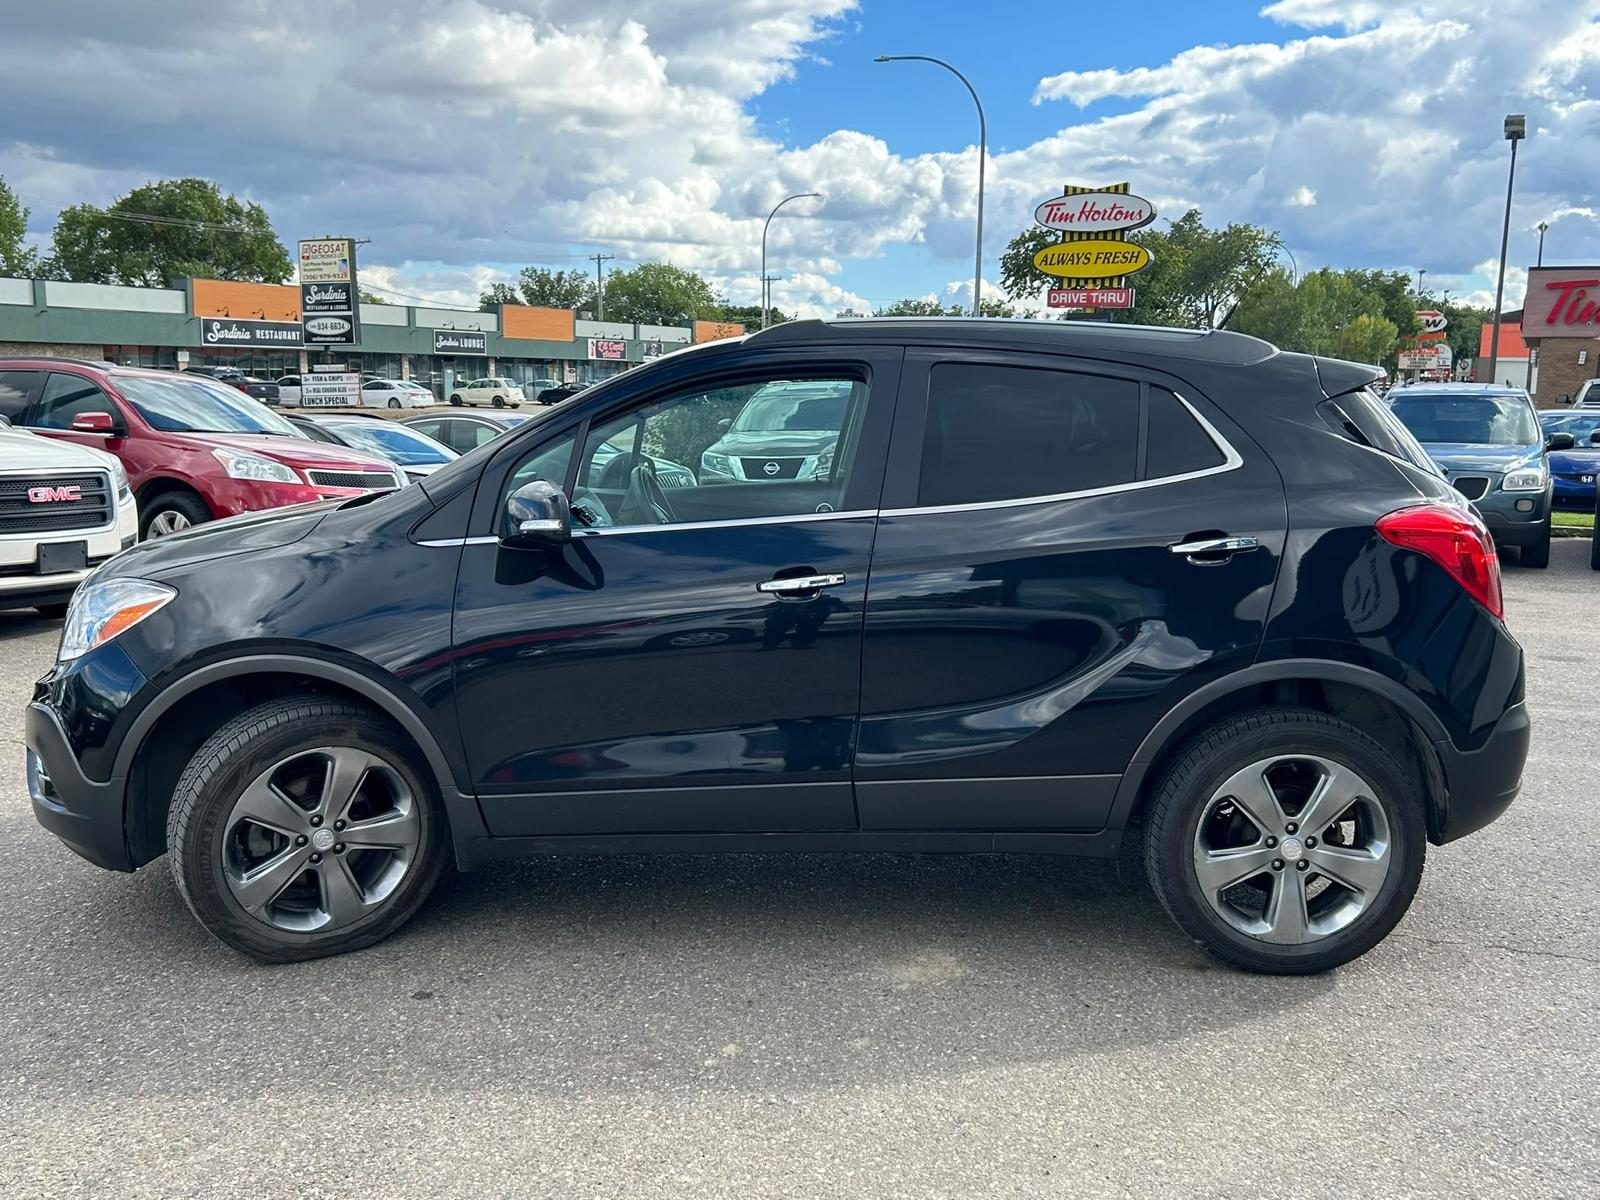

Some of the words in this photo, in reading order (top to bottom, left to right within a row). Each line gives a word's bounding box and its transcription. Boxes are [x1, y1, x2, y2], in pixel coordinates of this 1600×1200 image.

[1044, 202, 1075, 224] Tim
[1077, 200, 1143, 223] Hortons
[310, 243, 346, 255] GEOSAT
[1039, 252, 1092, 266] ALWAYS
[1093, 251, 1141, 265] FRESH
[305, 285, 347, 304] Sardinia
[1050, 293, 1088, 304] DRIVE
[1090, 292, 1126, 303] THRU
[207, 322, 252, 342] Sardinia
[255, 329, 301, 341] RESTAURANT
[436, 335, 459, 348] Sardinia
[460, 338, 484, 349] LOUNGE
[304, 397, 323, 406] LUNCH
[323, 396, 349, 405] SPECIAL
[28, 485, 82, 503] GMC
